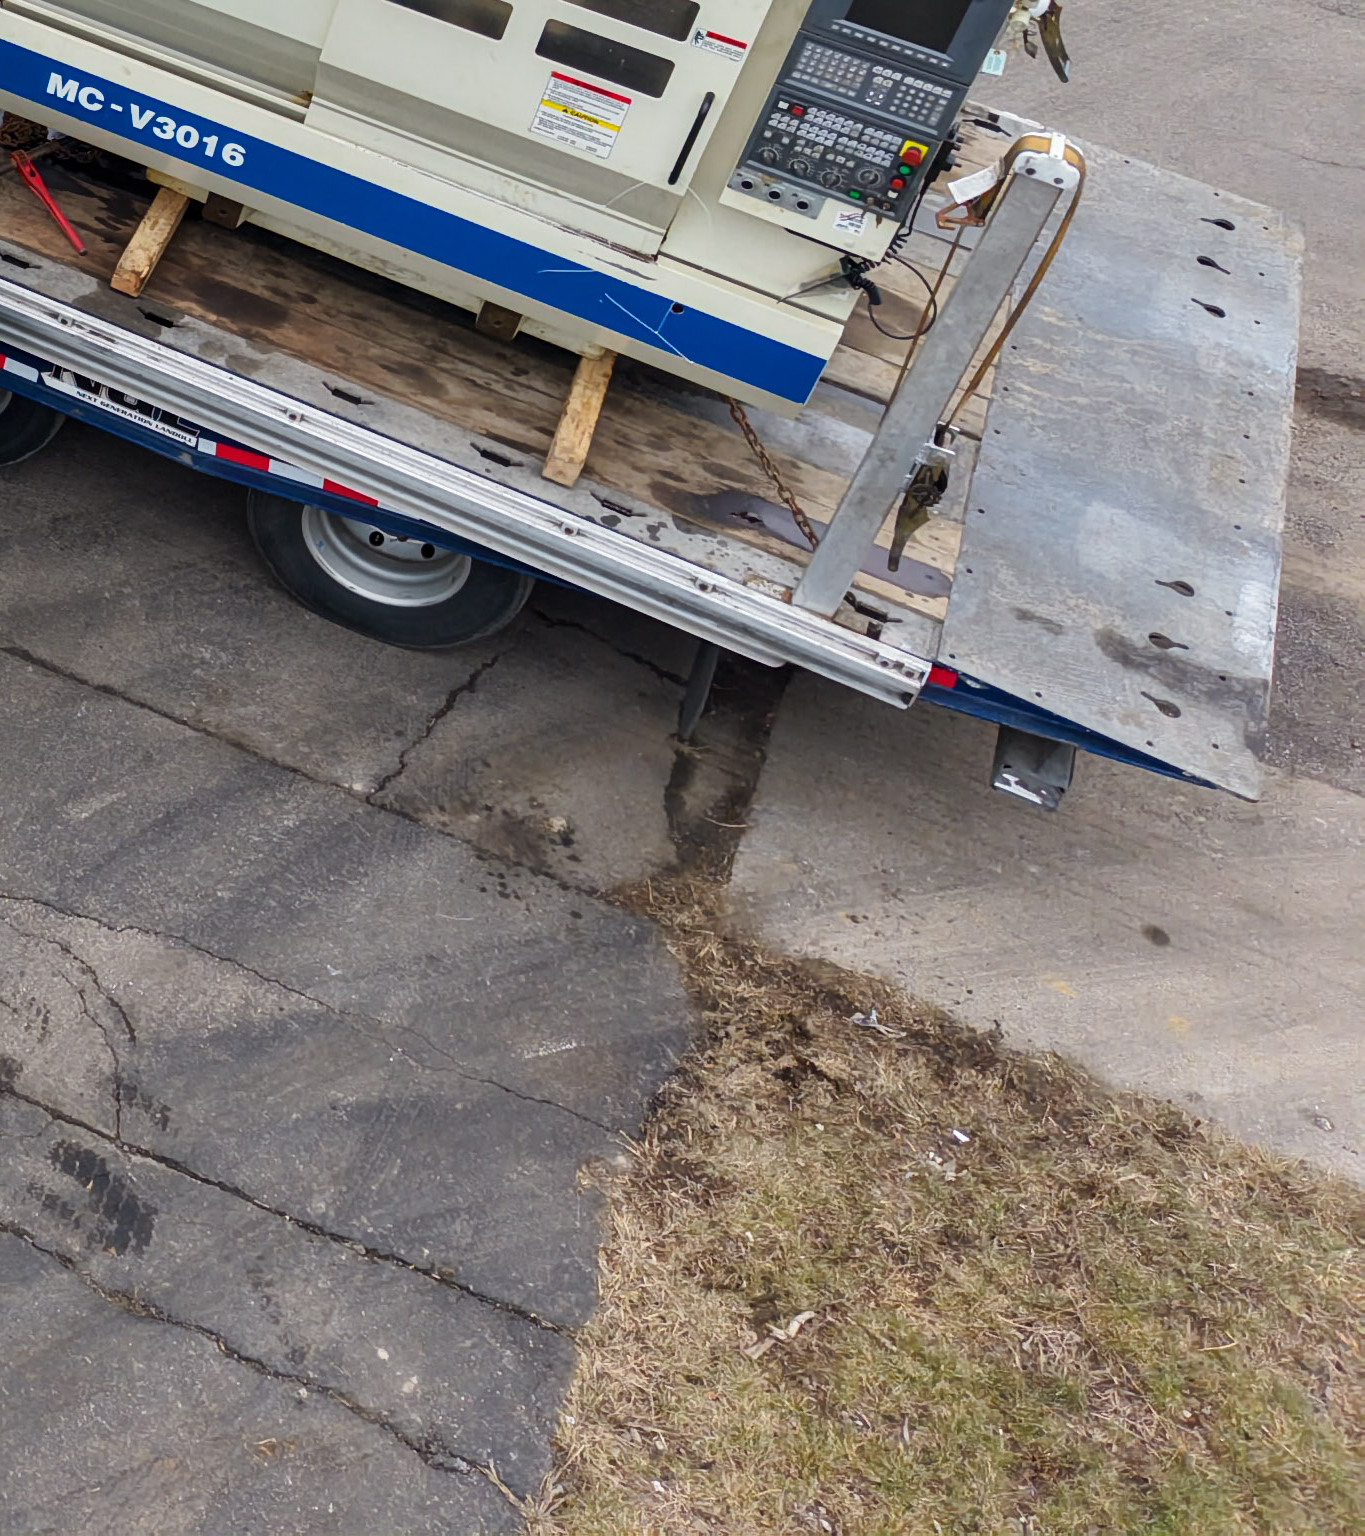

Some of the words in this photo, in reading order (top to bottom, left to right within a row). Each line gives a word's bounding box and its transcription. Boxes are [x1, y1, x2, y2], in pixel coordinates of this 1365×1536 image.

[570, 111, 599, 125] CAUTION
[76, 390, 98, 404] NEXT
[100, 400, 153, 427] GENERATION
[155, 423, 193, 444] LANDOLL
